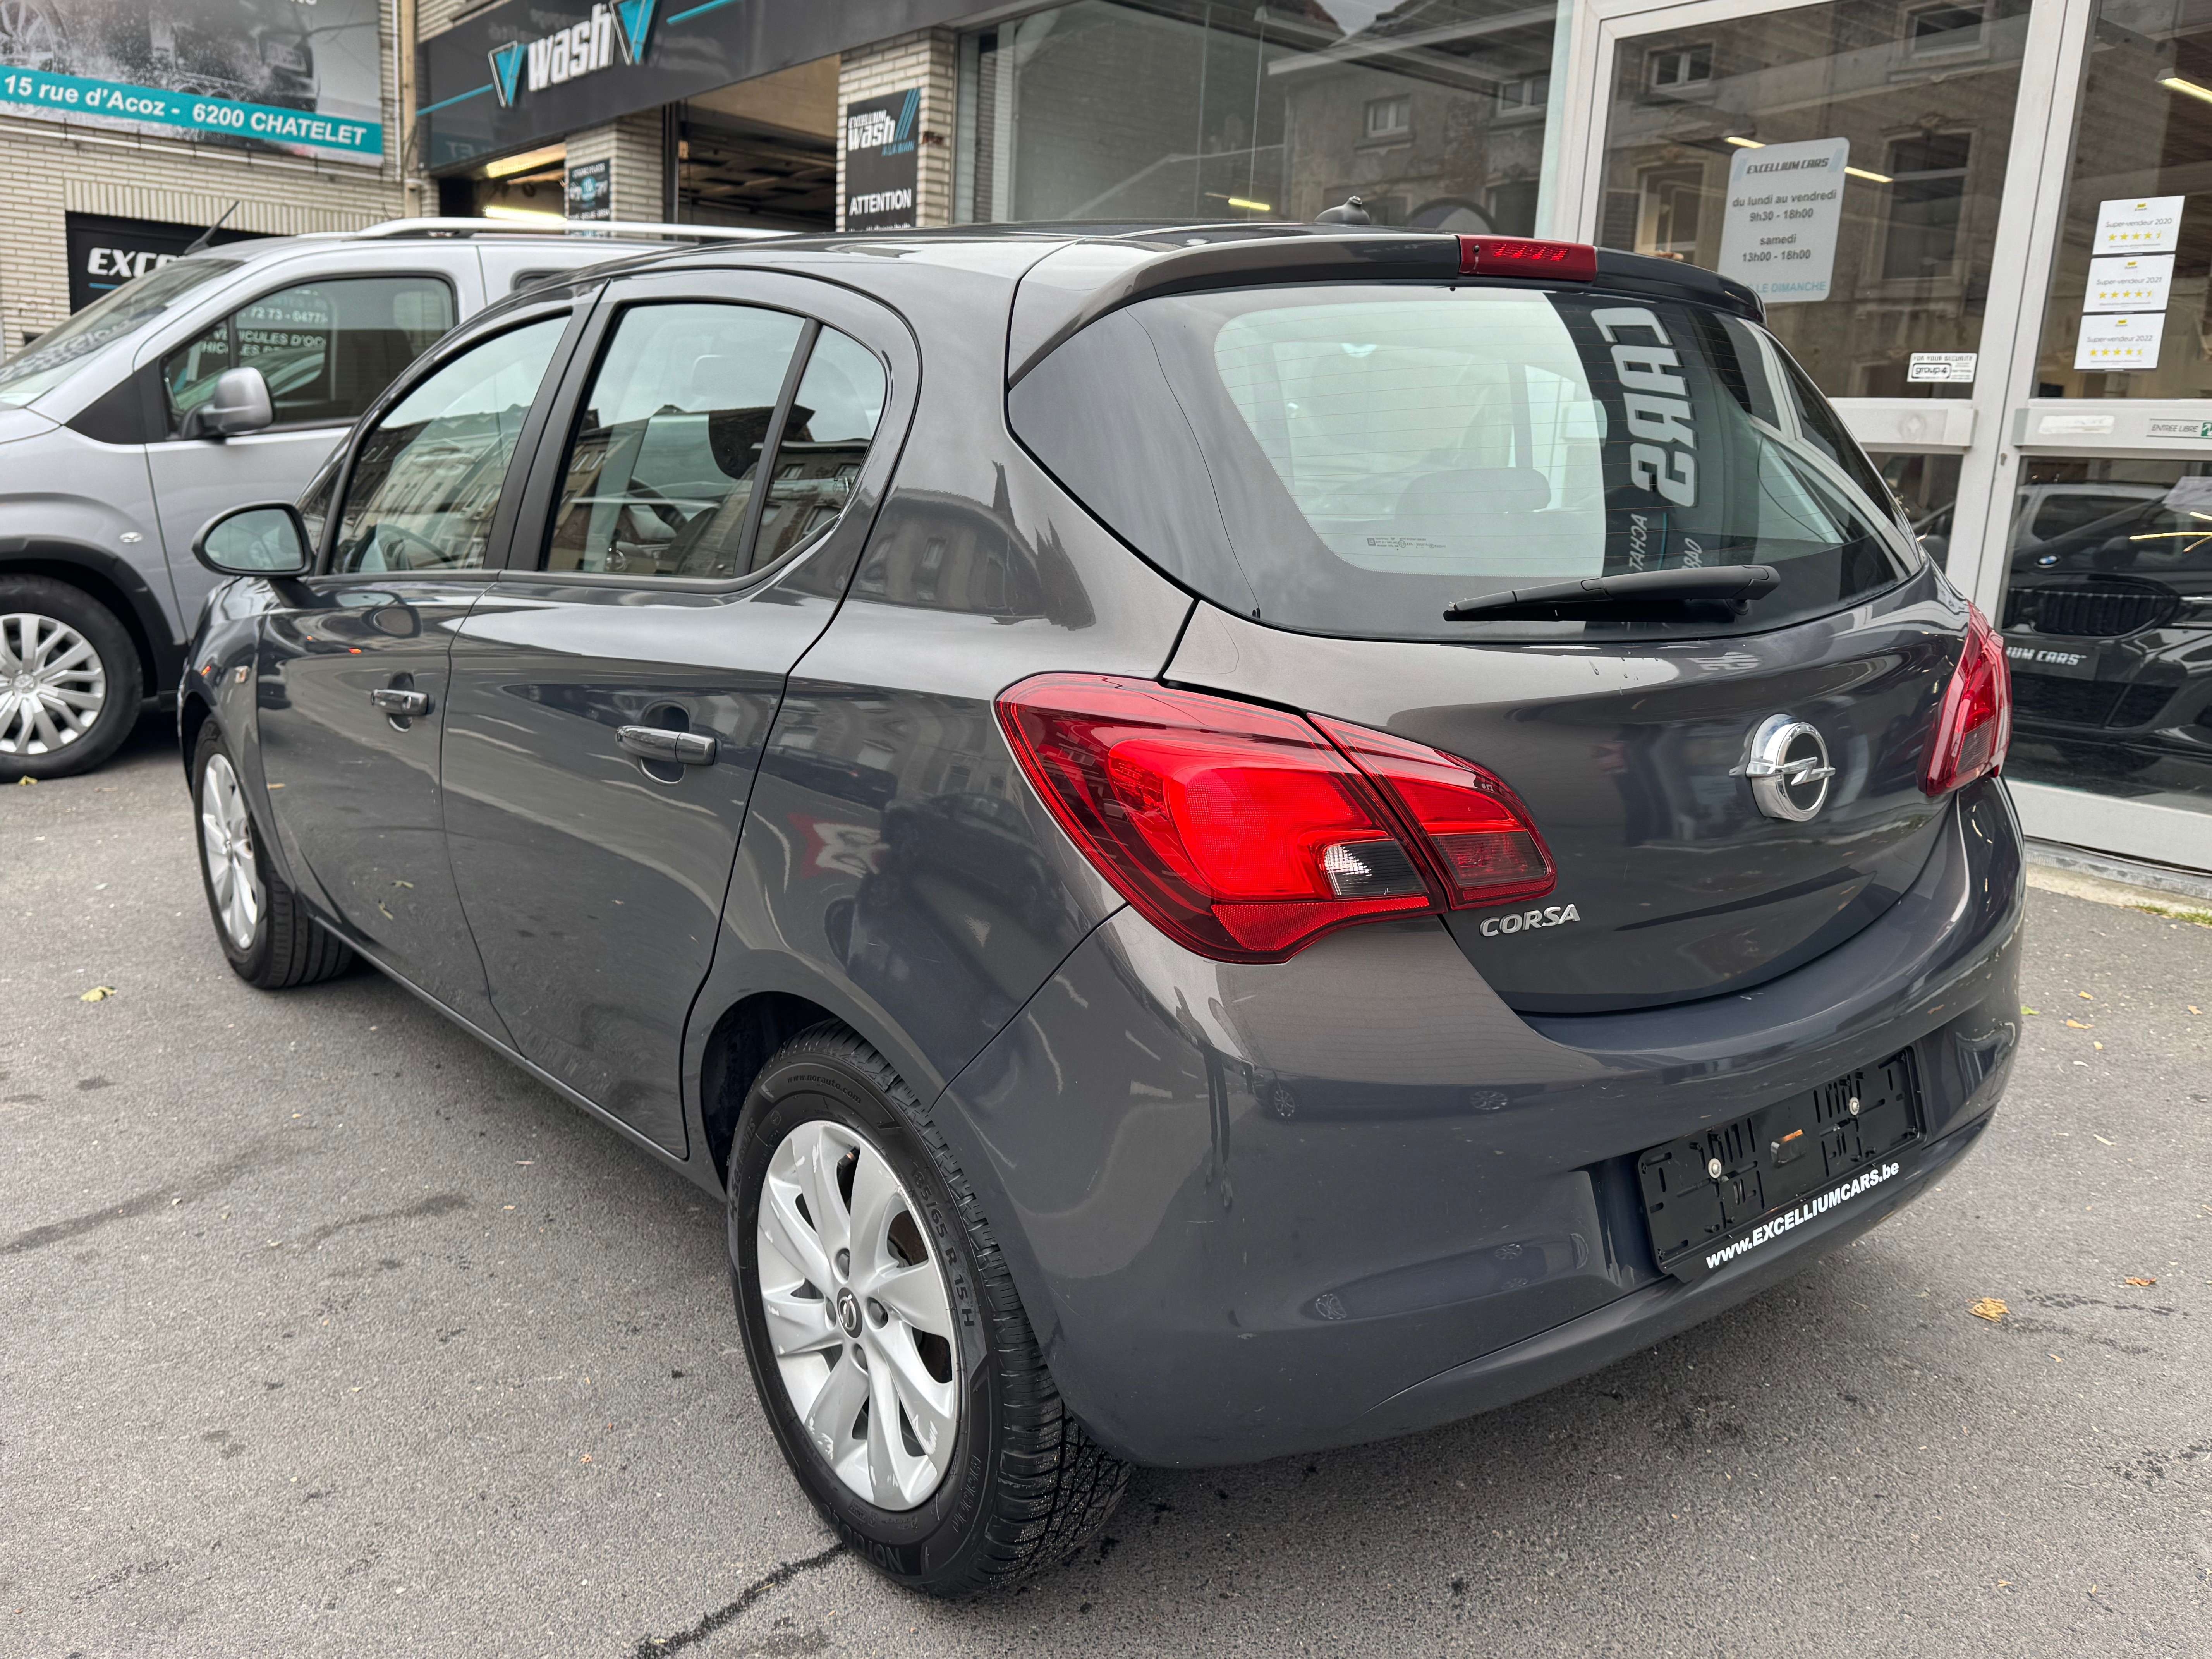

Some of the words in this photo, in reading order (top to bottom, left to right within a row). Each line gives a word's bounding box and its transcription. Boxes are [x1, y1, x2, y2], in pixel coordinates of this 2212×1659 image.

[528, 3, 613, 92] wash
[4, 74, 33, 97] 15
[39, 83, 79, 104] rue
[85, 87, 167, 117] d'Acoz
[192, 103, 245, 128] 6200
[250, 111, 367, 146] CHATELET
[848, 115, 896, 151] wash
[1747, 161, 1800, 174] EXCELLIUM
[1801, 157, 1830, 169] CARS
[848, 188, 912, 217] ATTENTION
[1732, 197, 1745, 207] du
[1747, 194, 1773, 206] lundi
[1791, 189, 1837, 203] vendredi
[1749, 211, 1774, 222] 9h30
[1784, 208, 1814, 220] 18h00
[2106, 218, 2154, 228] Super-vendeur
[1760, 234, 1797, 245] samedi
[1743, 251, 1772, 262] 13h00
[1781, 249, 1811, 261] 18h00
[1757, 283, 1769, 292] LE
[1772, 281, 1826, 292] DIMANCHE
[2178, 424, 2198, 433] LIBRE
[1479, 903, 1581, 937] CORSA
[787, 1073, 862, 1105] www.norauto.com
[1705, 1162, 1899, 1269] www.EXCELLIUMCARS.be
[911, 1160, 948, 1238] 185/65
[944, 1247, 957, 1267] R
[953, 1274, 968, 1300] 15
[961, 1308, 975, 1327] H
